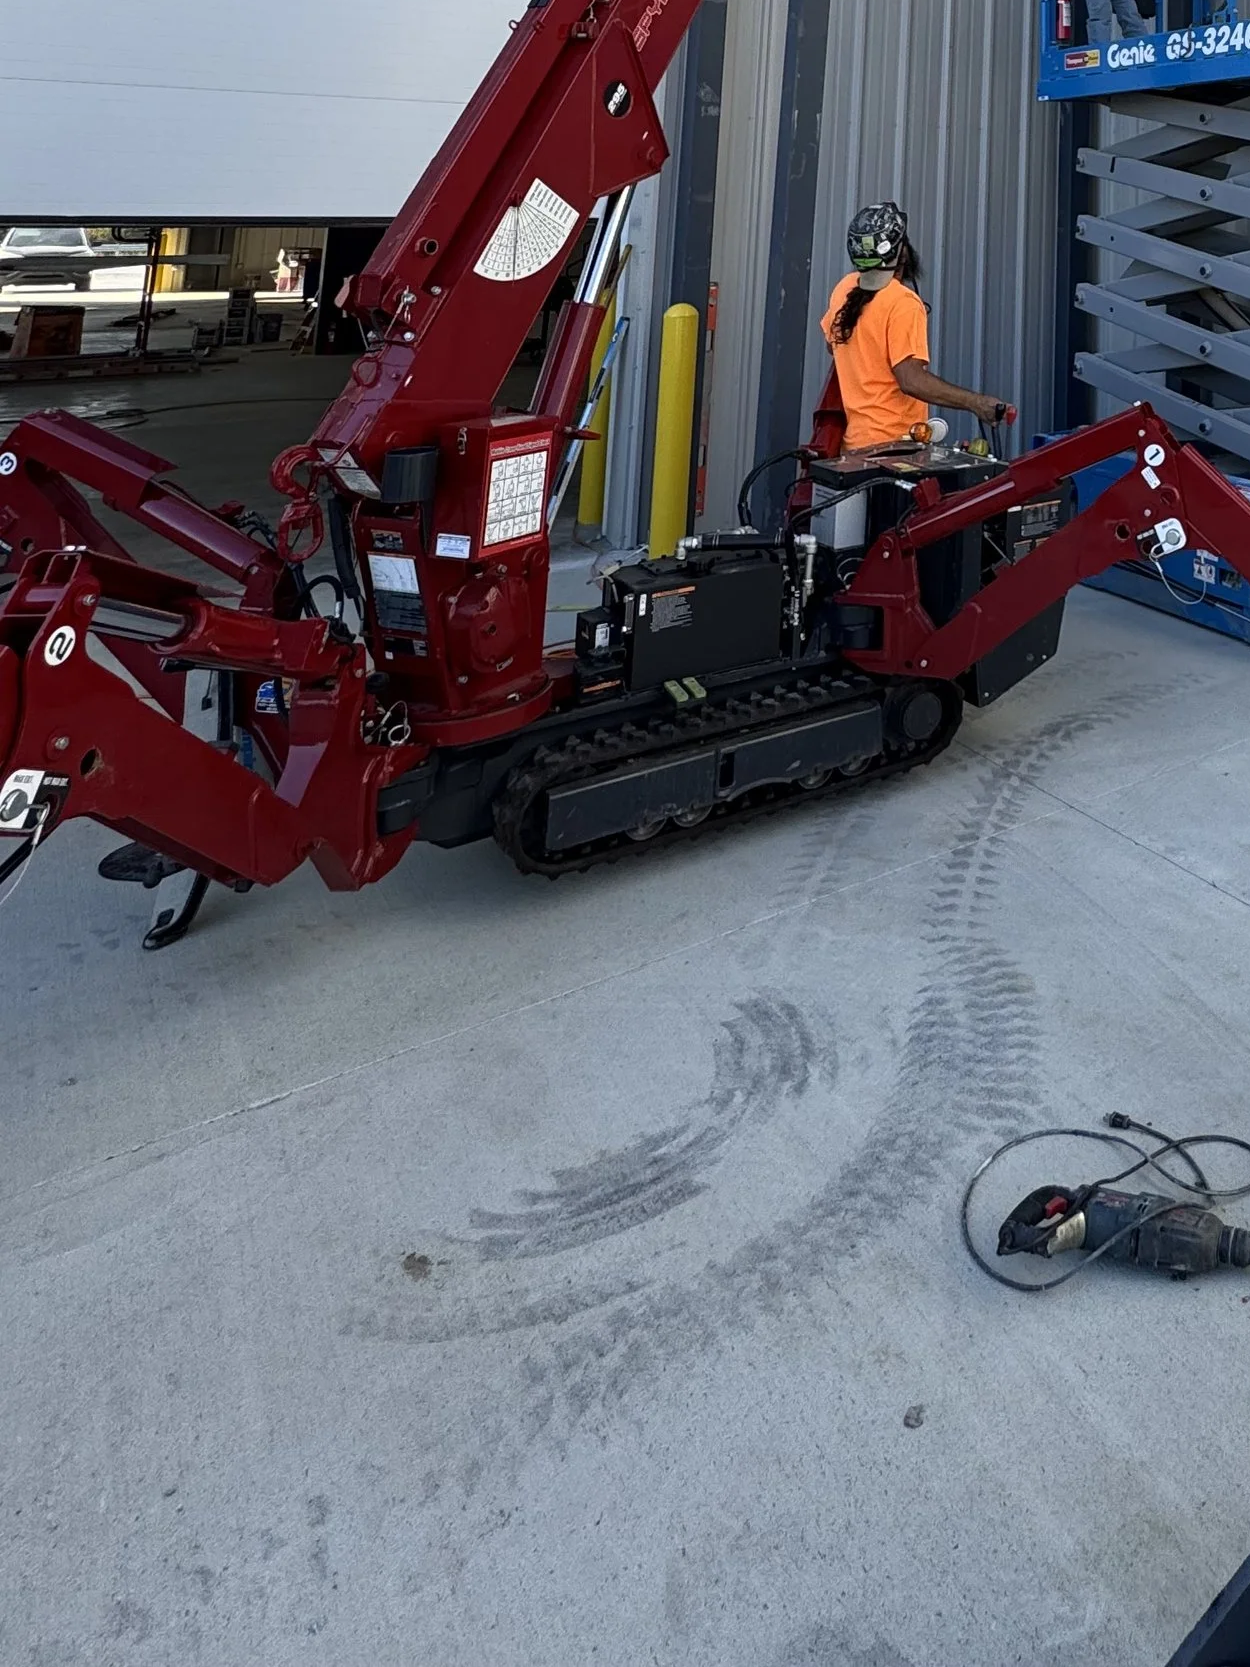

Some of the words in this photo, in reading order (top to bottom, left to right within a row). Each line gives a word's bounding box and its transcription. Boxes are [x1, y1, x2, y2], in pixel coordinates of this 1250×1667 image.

[1107, 40, 1156, 69] Genie
[0, 455, 14, 472] 3
[1149, 448, 1160, 461] 1
[49, 632, 73, 661] 2
